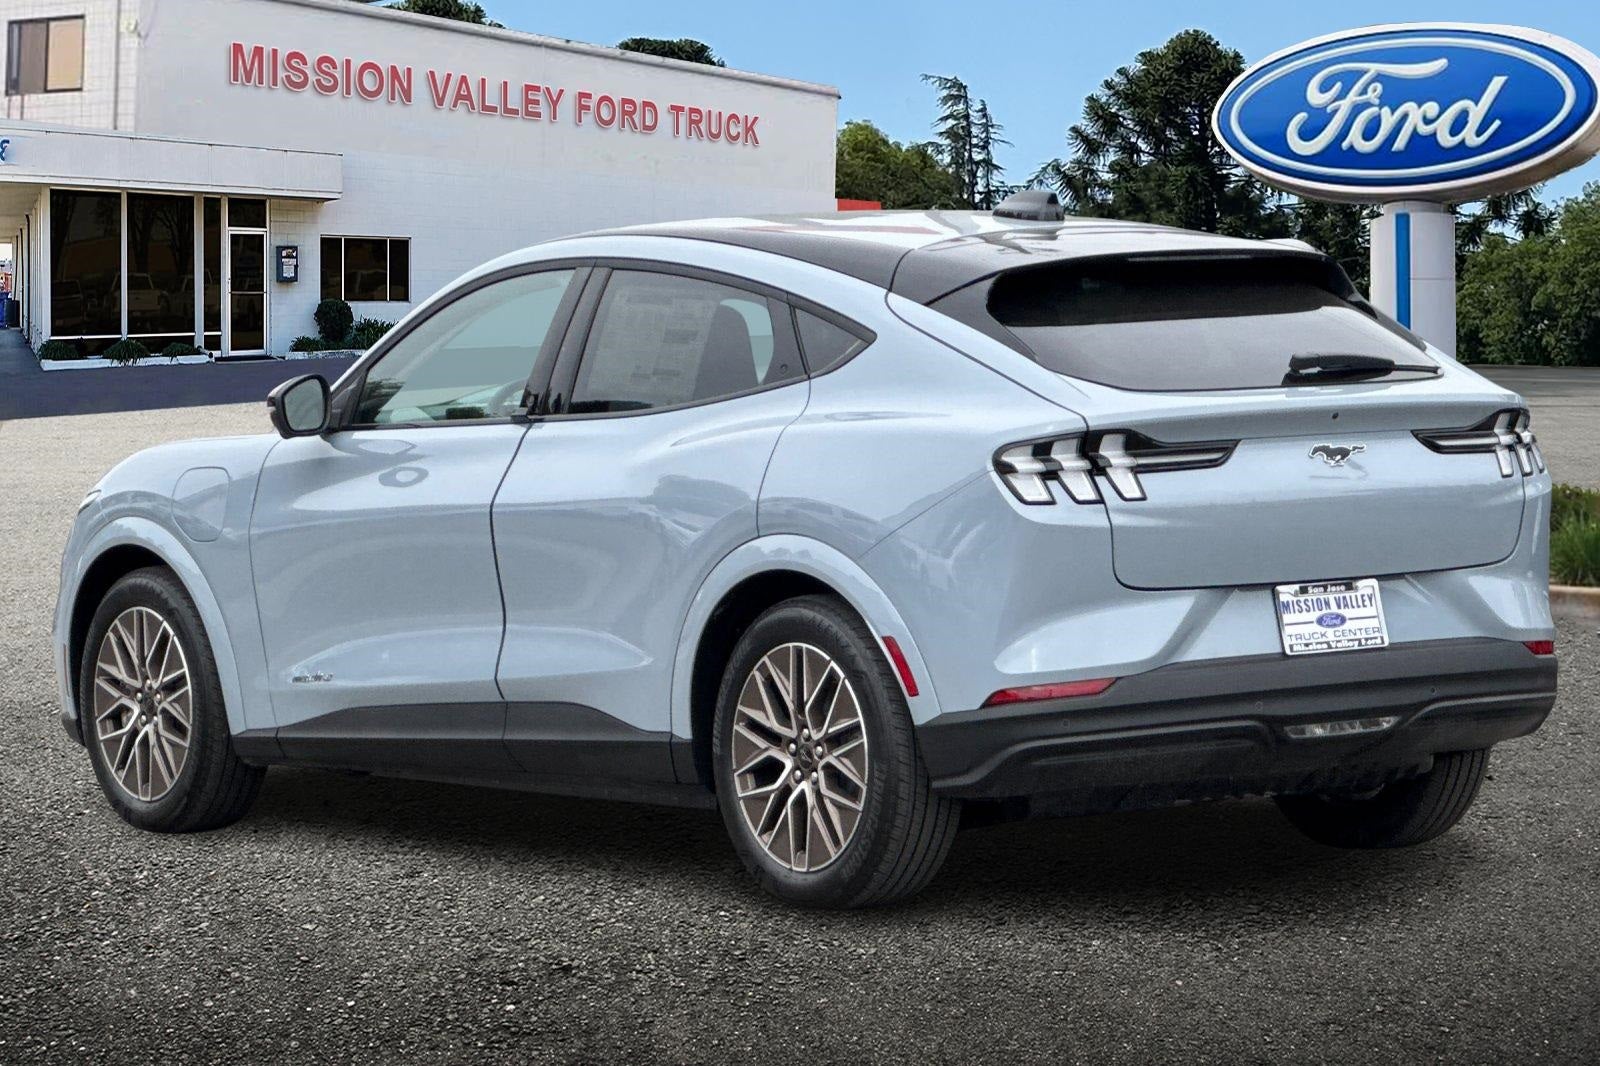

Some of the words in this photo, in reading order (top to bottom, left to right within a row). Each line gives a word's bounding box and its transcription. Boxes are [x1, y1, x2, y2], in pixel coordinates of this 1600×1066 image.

[229, 41, 414, 104] MISSION
[427, 69, 565, 121] VALLEY
[575, 90, 659, 133] FORD
[669, 104, 760, 145] TRUCK
[1286, 57, 1509, 156] Ford
[1308, 586, 1324, 594] San
[1280, 597, 1331, 614] MISSION
[1333, 593, 1374, 610] VALLEY
[1321, 614, 1342, 626] Ford
[1287, 631, 1328, 641] TRUCK
[1333, 627, 1381, 638] CENTER
